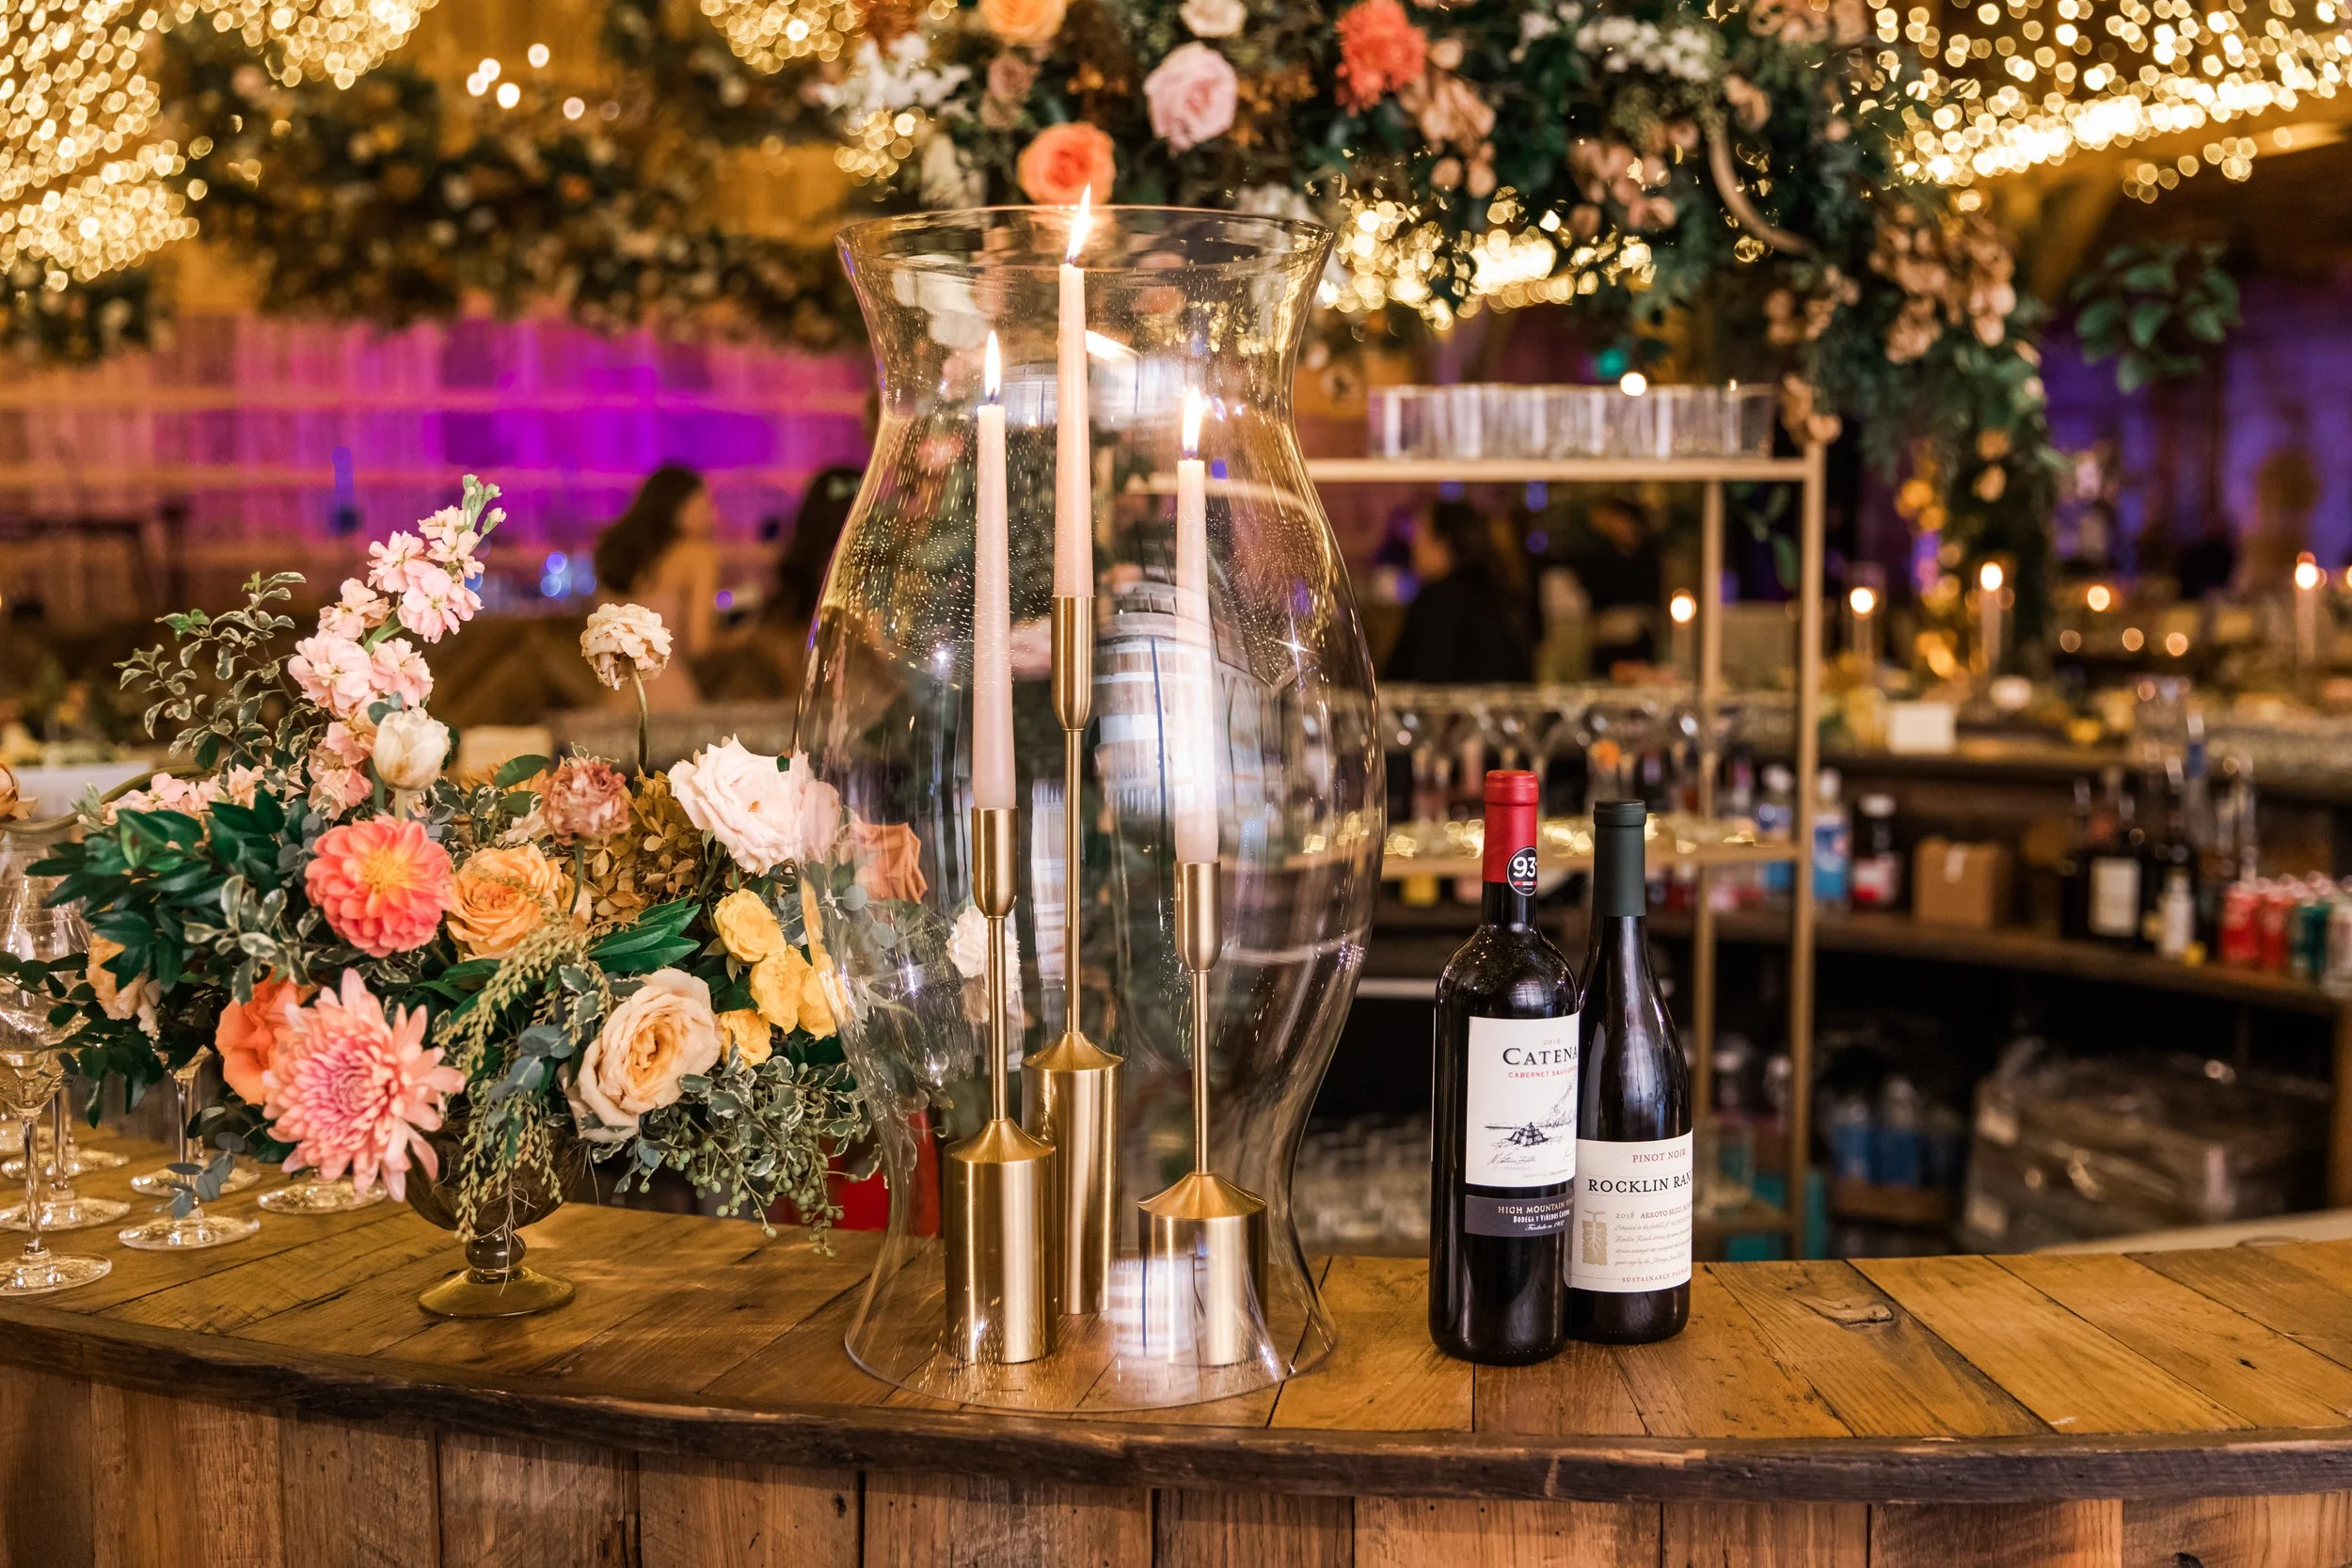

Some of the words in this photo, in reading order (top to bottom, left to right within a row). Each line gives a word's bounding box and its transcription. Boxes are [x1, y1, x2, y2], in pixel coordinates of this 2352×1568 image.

[1632, 1152, 1665, 1164] PINOT
[1667, 1148, 1686, 1160] NOIR
[1587, 1178, 1669, 1193] ROCKLIN
[1498, 1206, 1523, 1214] HIGH
[1526, 1201, 1565, 1213] MOUNTAIN
[1513, 1214, 1534, 1224] BODEGA
[1640, 1210, 1668, 1219] ARROYO
[1622, 1273, 1670, 1283] SUSTAINABLY
